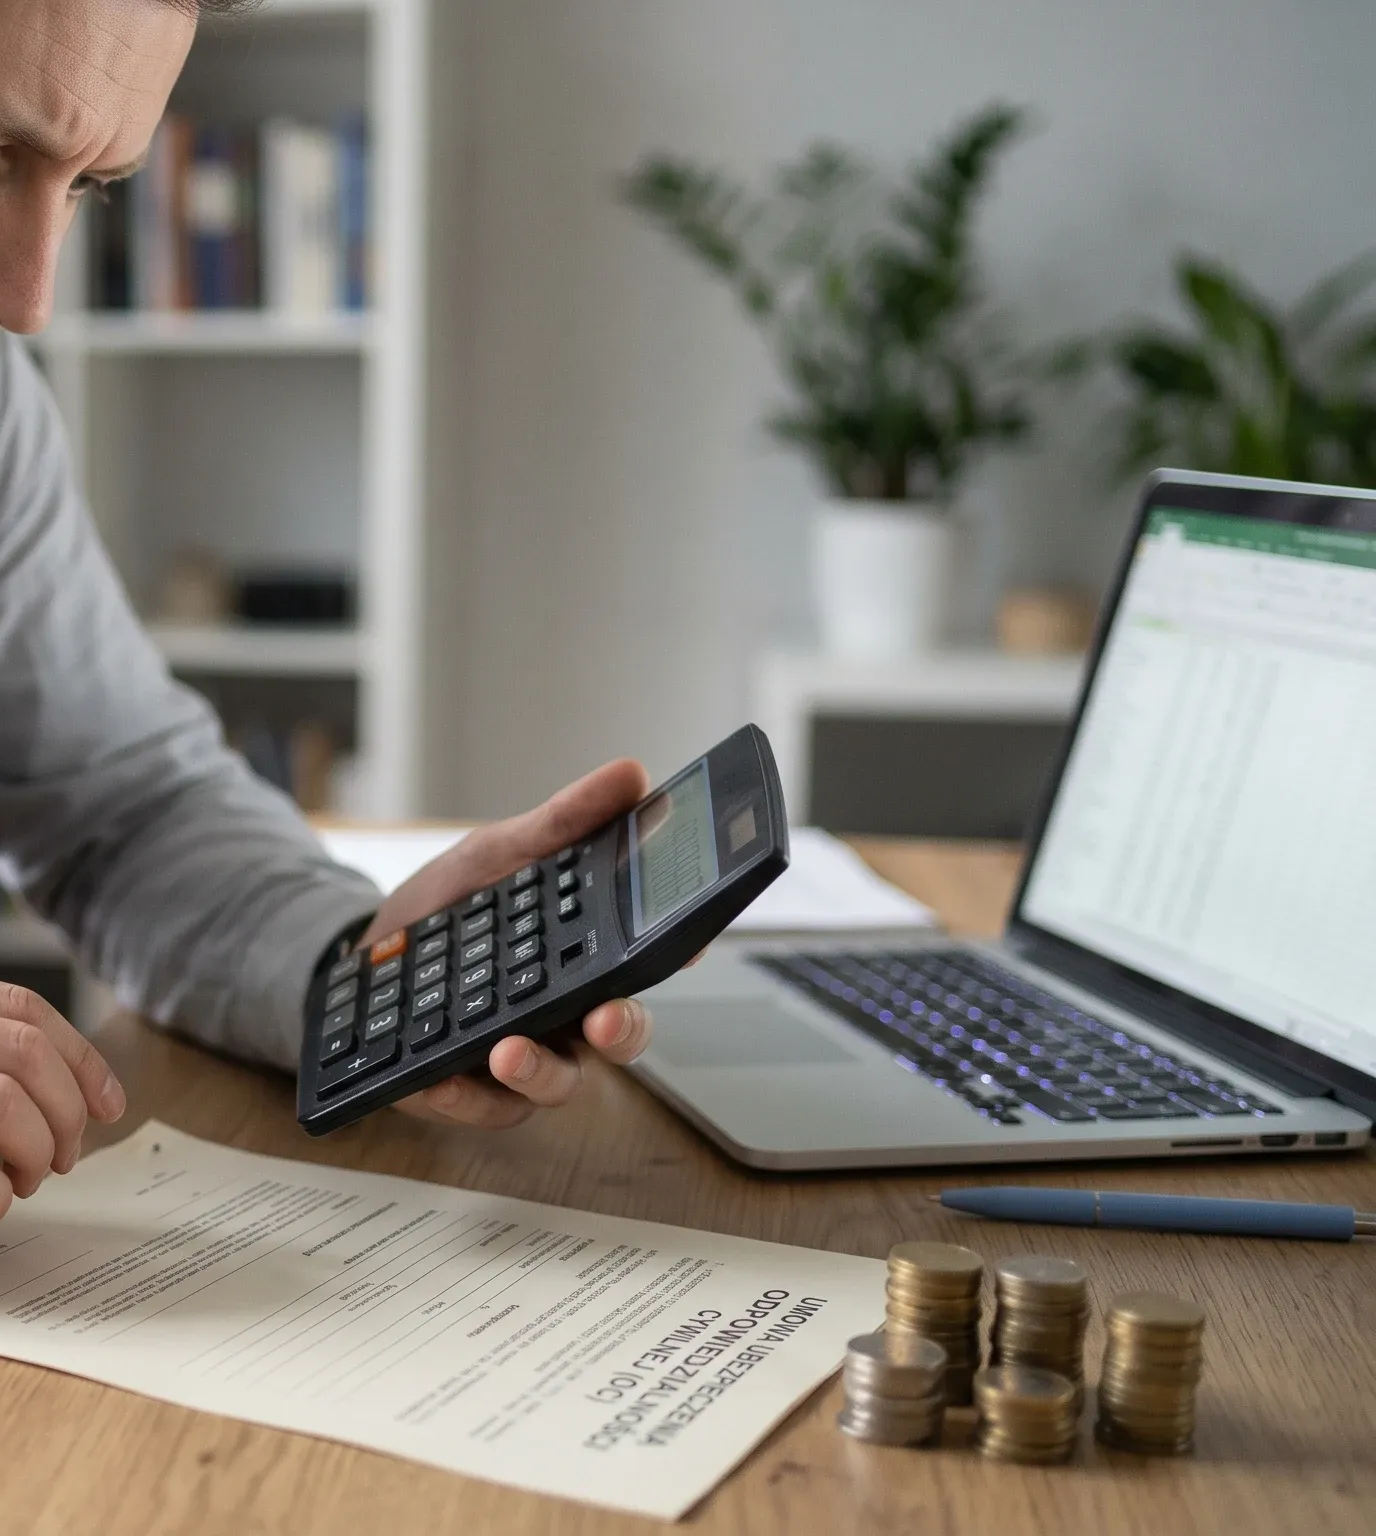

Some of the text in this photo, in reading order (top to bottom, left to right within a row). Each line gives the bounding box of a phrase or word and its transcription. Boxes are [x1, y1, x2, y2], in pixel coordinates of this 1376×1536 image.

[465, 943, 487, 958] 8
[420, 964, 441, 979] 5
[464, 969, 486, 983] 9
[374, 988, 394, 1003] 2
[418, 991, 440, 1007] 6
[370, 1016, 392, 1031] 3
[763, 1296, 828, 1345] UMOWA
[585, 1309, 722, 1403] CYWILNEJ (OC)
[583, 1289, 790, 1451] ODPOWIEDZIALNOŚCI
[643, 1344, 775, 1447] UBEZPIECZENIA
